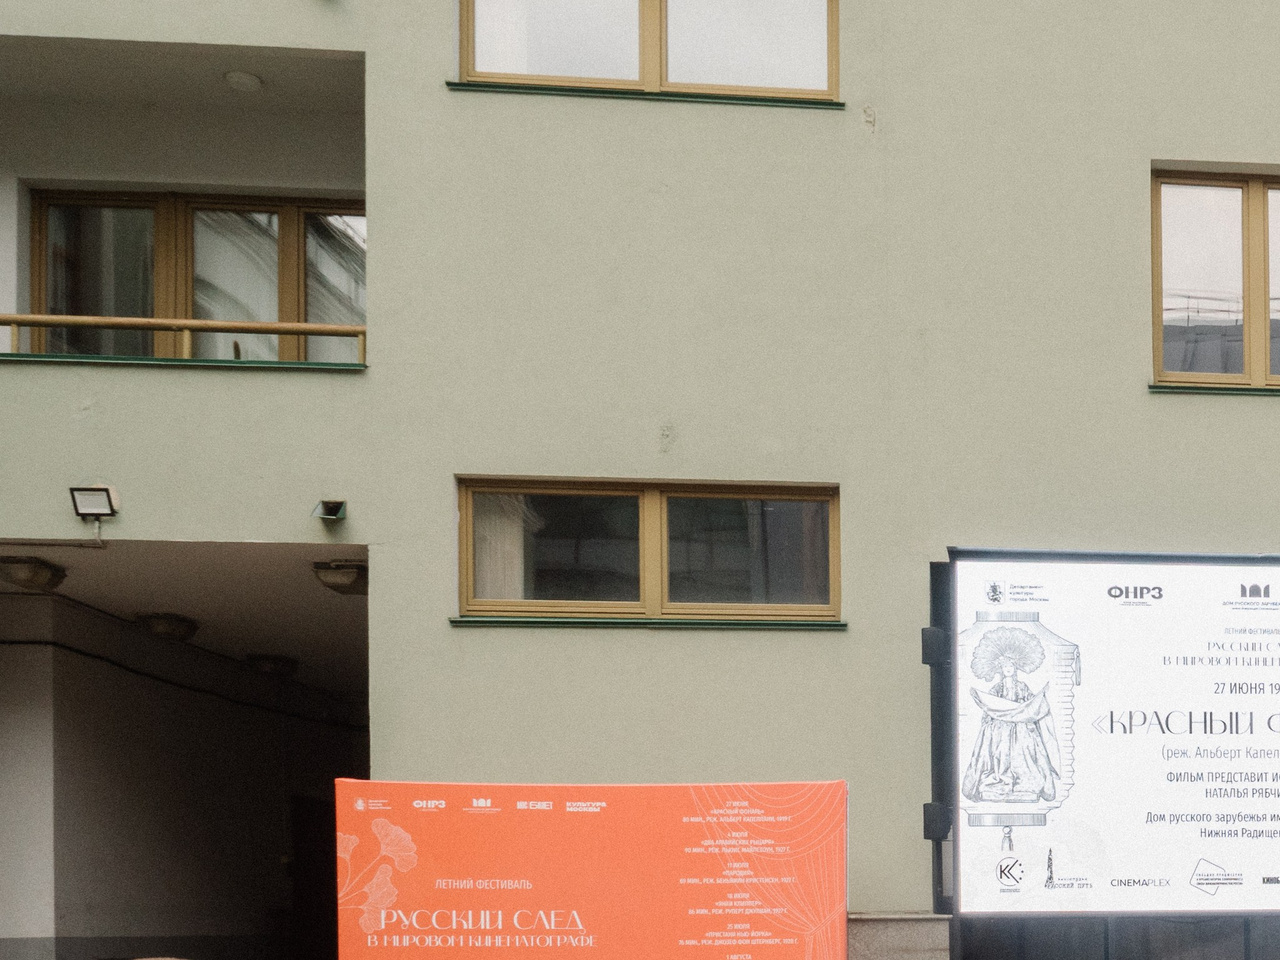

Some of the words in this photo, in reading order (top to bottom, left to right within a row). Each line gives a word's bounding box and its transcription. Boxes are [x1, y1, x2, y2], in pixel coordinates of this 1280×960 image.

[1107, 585, 1163, 599] ФНРЗ
[1224, 627, 1247, 635] ЛЕТНИЙ
[1248, 627, 1280, 635] ФЕСТИВАЛЬ
[1214, 683, 1225, 695] 27
[1229, 683, 1265, 695] ИЮНЯ
[1091, 710, 1254, 735] «КРАСНЫЙ
[1161, 745, 1191, 760] (реж.
[1195, 747, 1242, 760] Альберт
[1166, 772, 1204, 783] ФИЛЬМ
[1207, 772, 1269, 783] ПРЕДСТАВИТ
[1205, 788, 1248, 799] НАТАЛЬЯ
[1145, 812, 1166, 824] Дом
[1169, 813, 1212, 825] русского
[1215, 812, 1267, 825] зарубежья
[1200, 828, 1238, 838] Нижняя
[435, 879, 474, 889] ЛЕТНИЙ
[476, 879, 532, 889] ФЕСТИВАЛЬ
[1110, 879, 1170, 887] CINEMAPLEX
[380, 909, 503, 929] РУССКИЙ
[513, 910, 586, 934] СЛЕД
[367, 935, 378, 947] В
[384, 935, 464, 947] МИРОВОМ
[469, 935, 598, 947] КИНЕМАТОГРАФЕ
